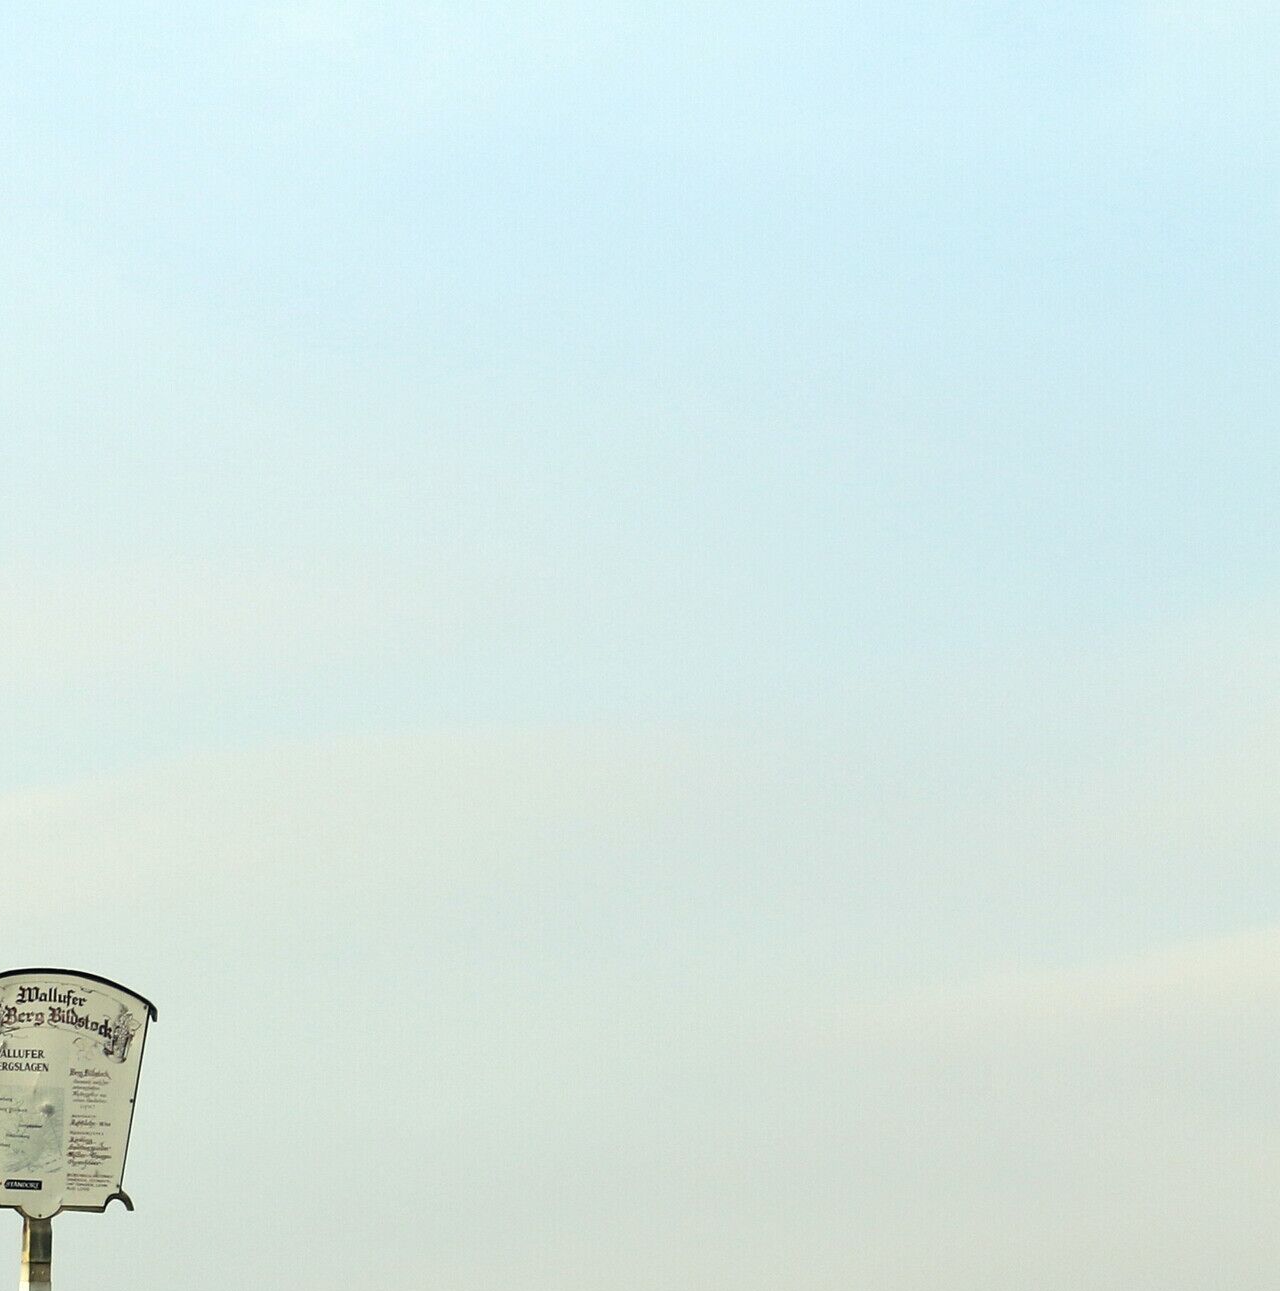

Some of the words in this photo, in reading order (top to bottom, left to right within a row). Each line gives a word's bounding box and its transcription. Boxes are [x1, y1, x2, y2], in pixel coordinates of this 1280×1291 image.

[16, 986, 87, 1007] Wallufer
[1, 1005, 44, 1026] Berg
[48, 1006, 112, 1040] Bildstock
